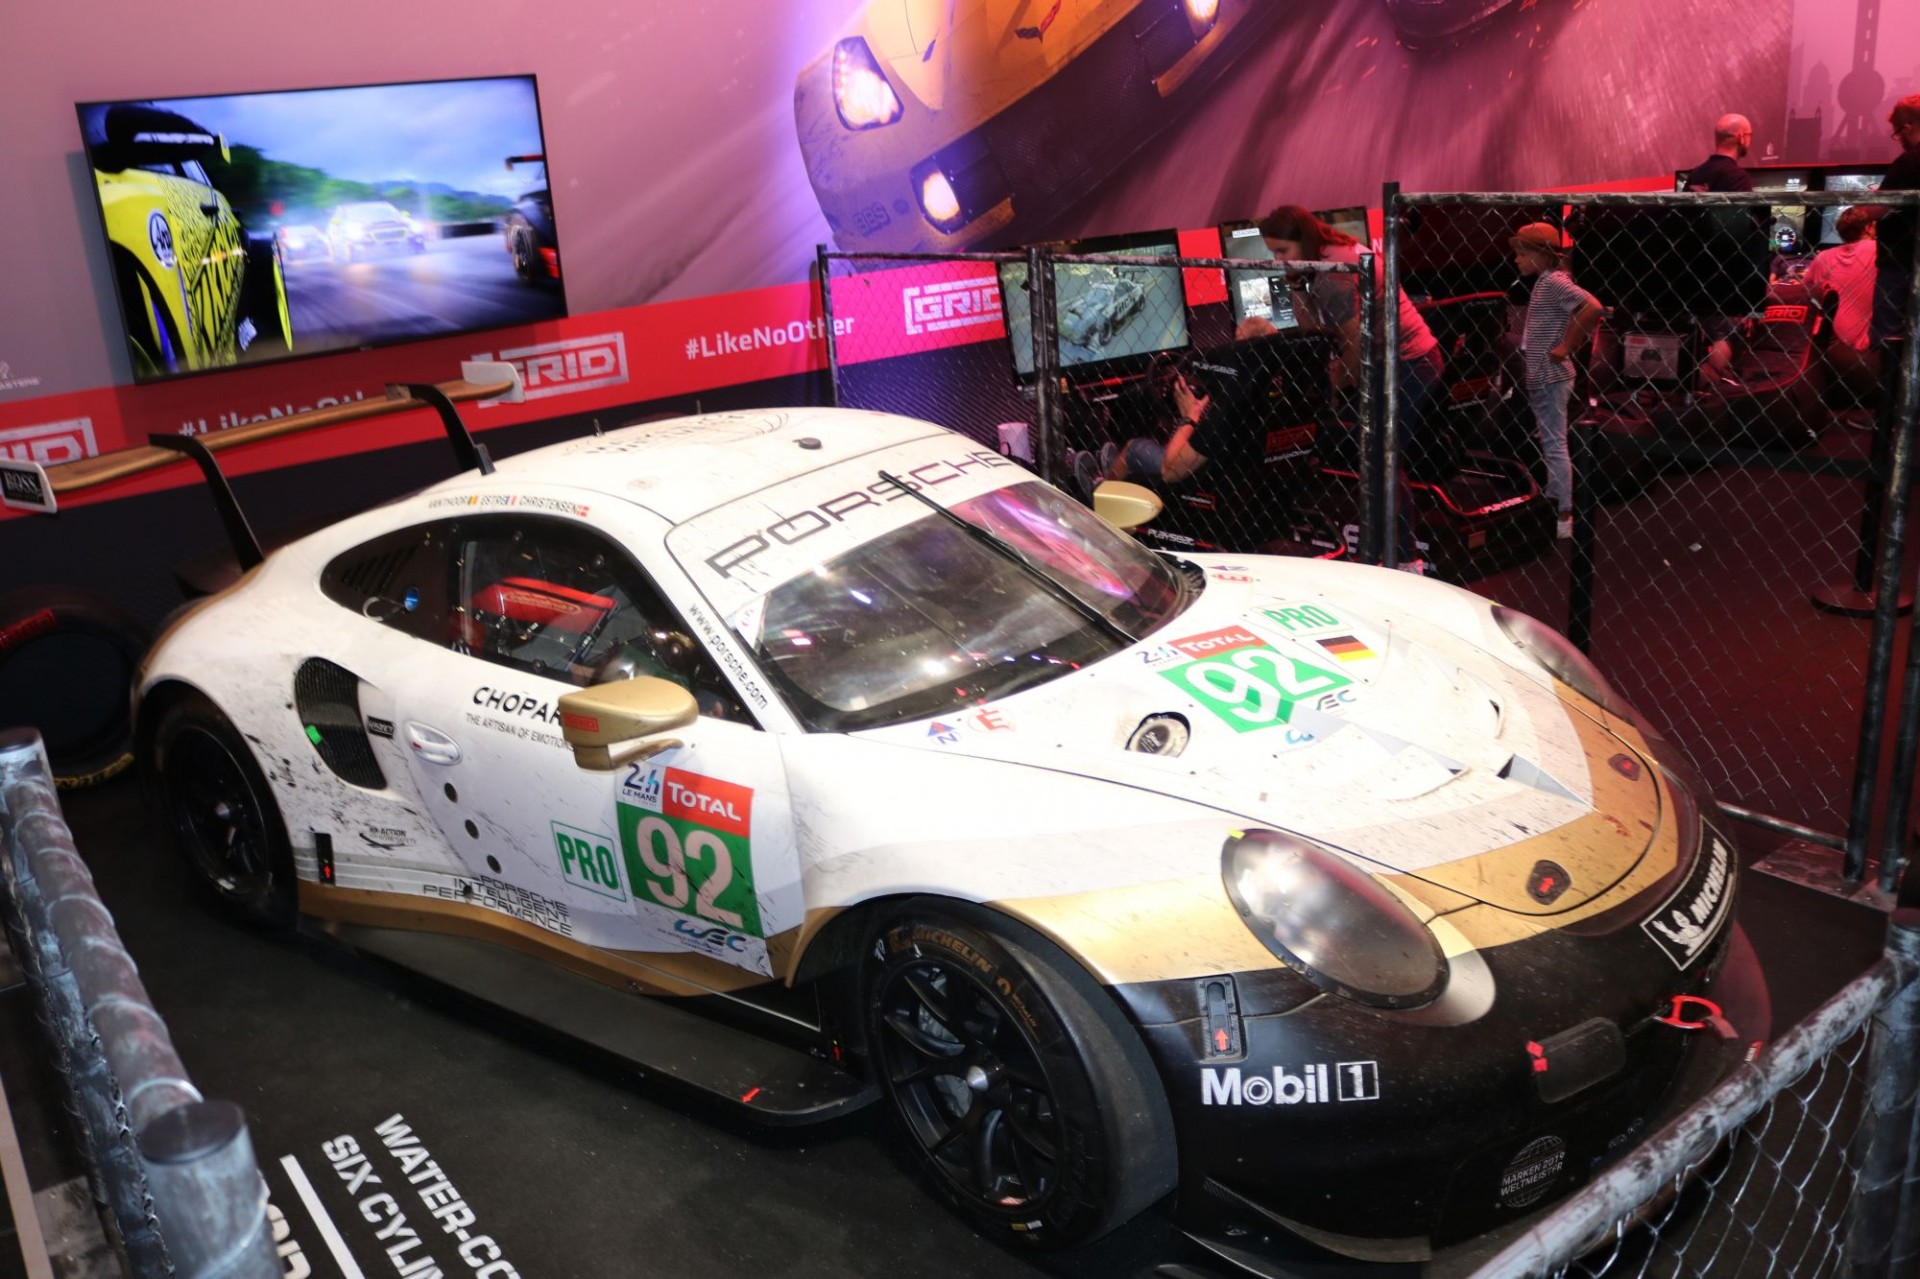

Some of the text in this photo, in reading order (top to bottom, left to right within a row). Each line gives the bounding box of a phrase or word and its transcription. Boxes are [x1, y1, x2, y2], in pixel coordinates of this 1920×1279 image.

[705, 452, 1012, 579] PORSCHE
[1263, 605, 1339, 631] PRO
[689, 602, 769, 711] www.porsche.com
[1178, 633, 1256, 653] TOTAL
[1186, 648, 1337, 723] 92
[367, 721, 394, 734] HAZET
[466, 713, 481, 726] THE
[482, 719, 517, 735] ARTISAN
[518, 728, 530, 740] OF
[622, 787, 633, 797] LE
[633, 790, 657, 804] MANS
[667, 781, 742, 822] TOTAL
[557, 832, 619, 891] PRO
[637, 815, 744, 929] 92
[1689, 838, 1728, 924] MICHELIN
[454, 877, 571, 923] INTELLIGENT
[479, 875, 568, 914] PORSCHE
[912, 929, 993, 973] MICHELIN
[1201, 1063, 1328, 1106] Mobil
[321, 1134, 382, 1195] SIX
[1501, 1162, 1563, 1197] WELTMEISTER
[1503, 1159, 1542, 1185] MARKEN
